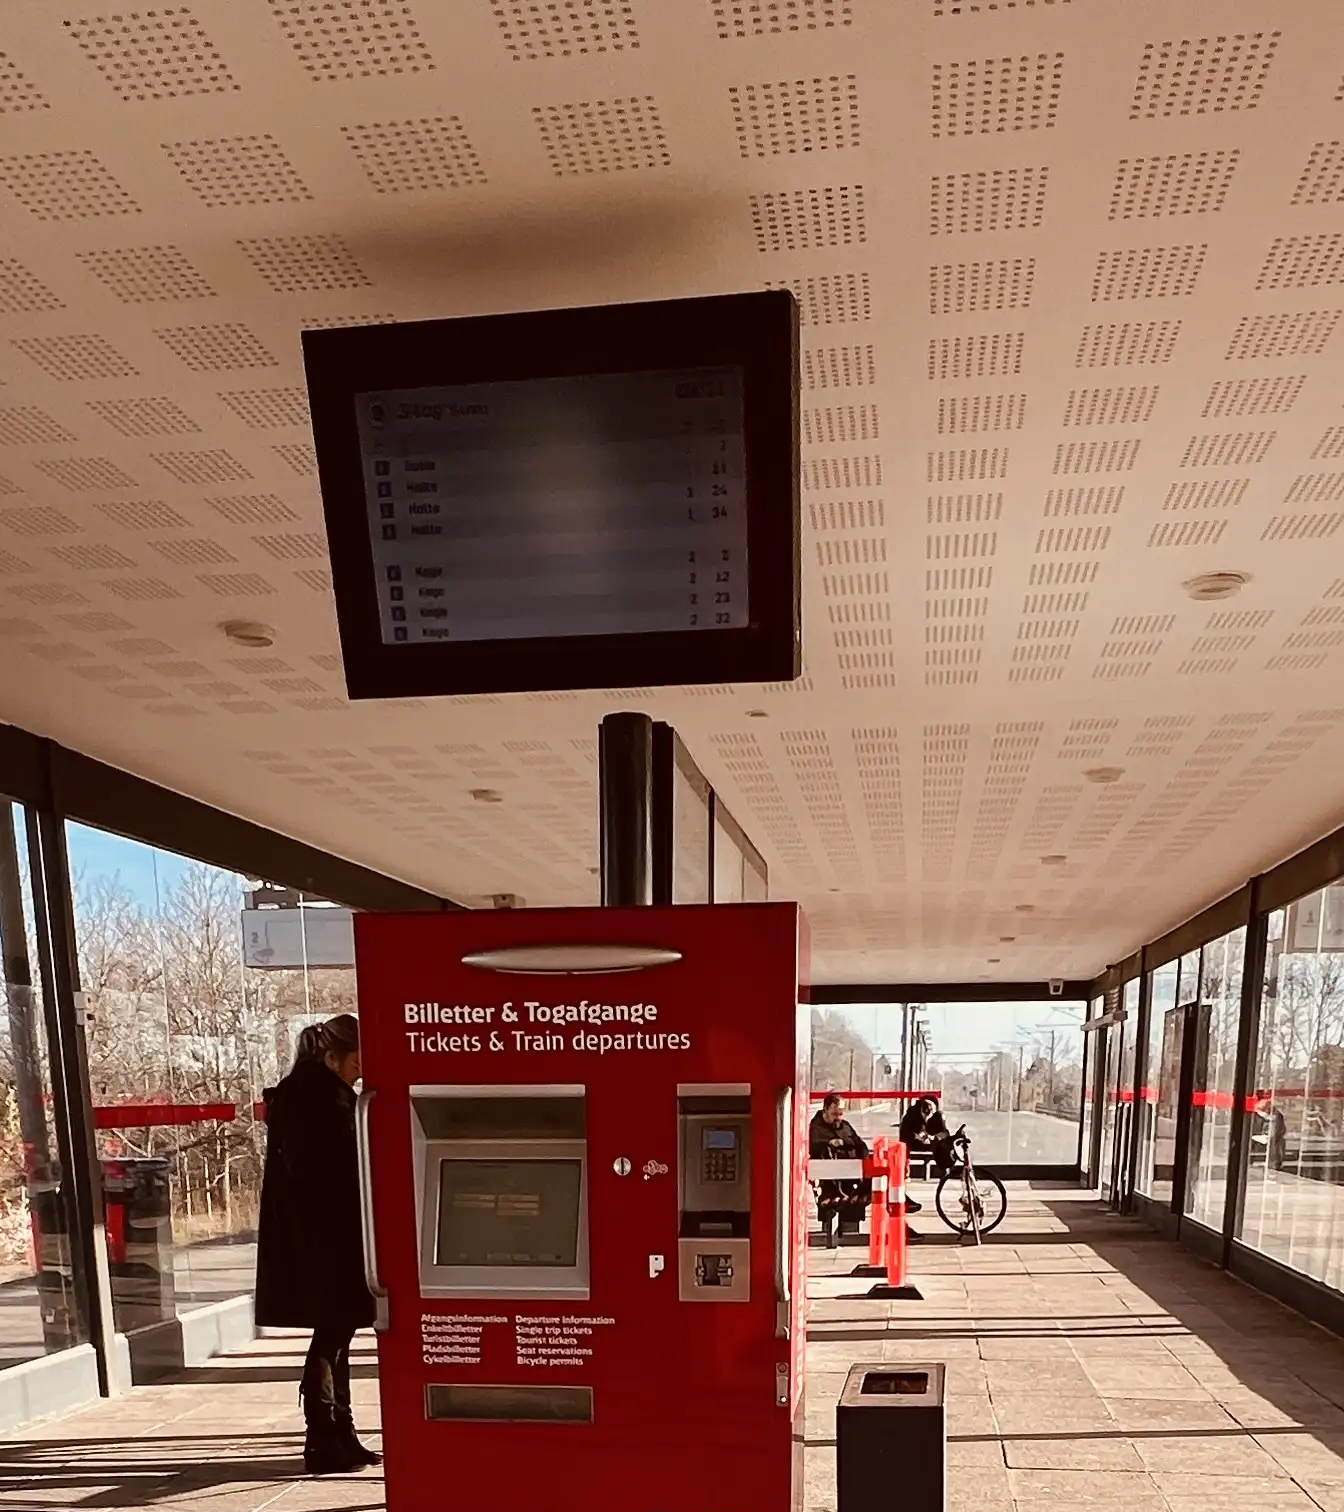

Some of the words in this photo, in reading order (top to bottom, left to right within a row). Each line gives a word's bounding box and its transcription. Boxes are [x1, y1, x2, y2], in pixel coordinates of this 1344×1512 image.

[404, 1003, 496, 1024] Billetter
[501, 1002, 519, 1023] &
[523, 1001, 658, 1026] Togafgange
[405, 1032, 482, 1053] Tickets
[489, 1031, 505, 1052] &
[511, 1031, 564, 1052] Train
[572, 1030, 691, 1055] departures
[515, 1315, 560, 1325] Departure
[562, 1315, 615, 1324] information
[516, 1325, 543, 1335] Single
[545, 1326, 561, 1336] trip
[563, 1326, 593, 1335] tickets
[516, 1335, 547, 1345] Tourist
[549, 1336, 578, 1345] tickets
[516, 1346, 536, 1355] Seat
[538, 1347, 593, 1355] reservations
[517, 1356, 547, 1366] Bicycle
[549, 1357, 584, 1366] permits
